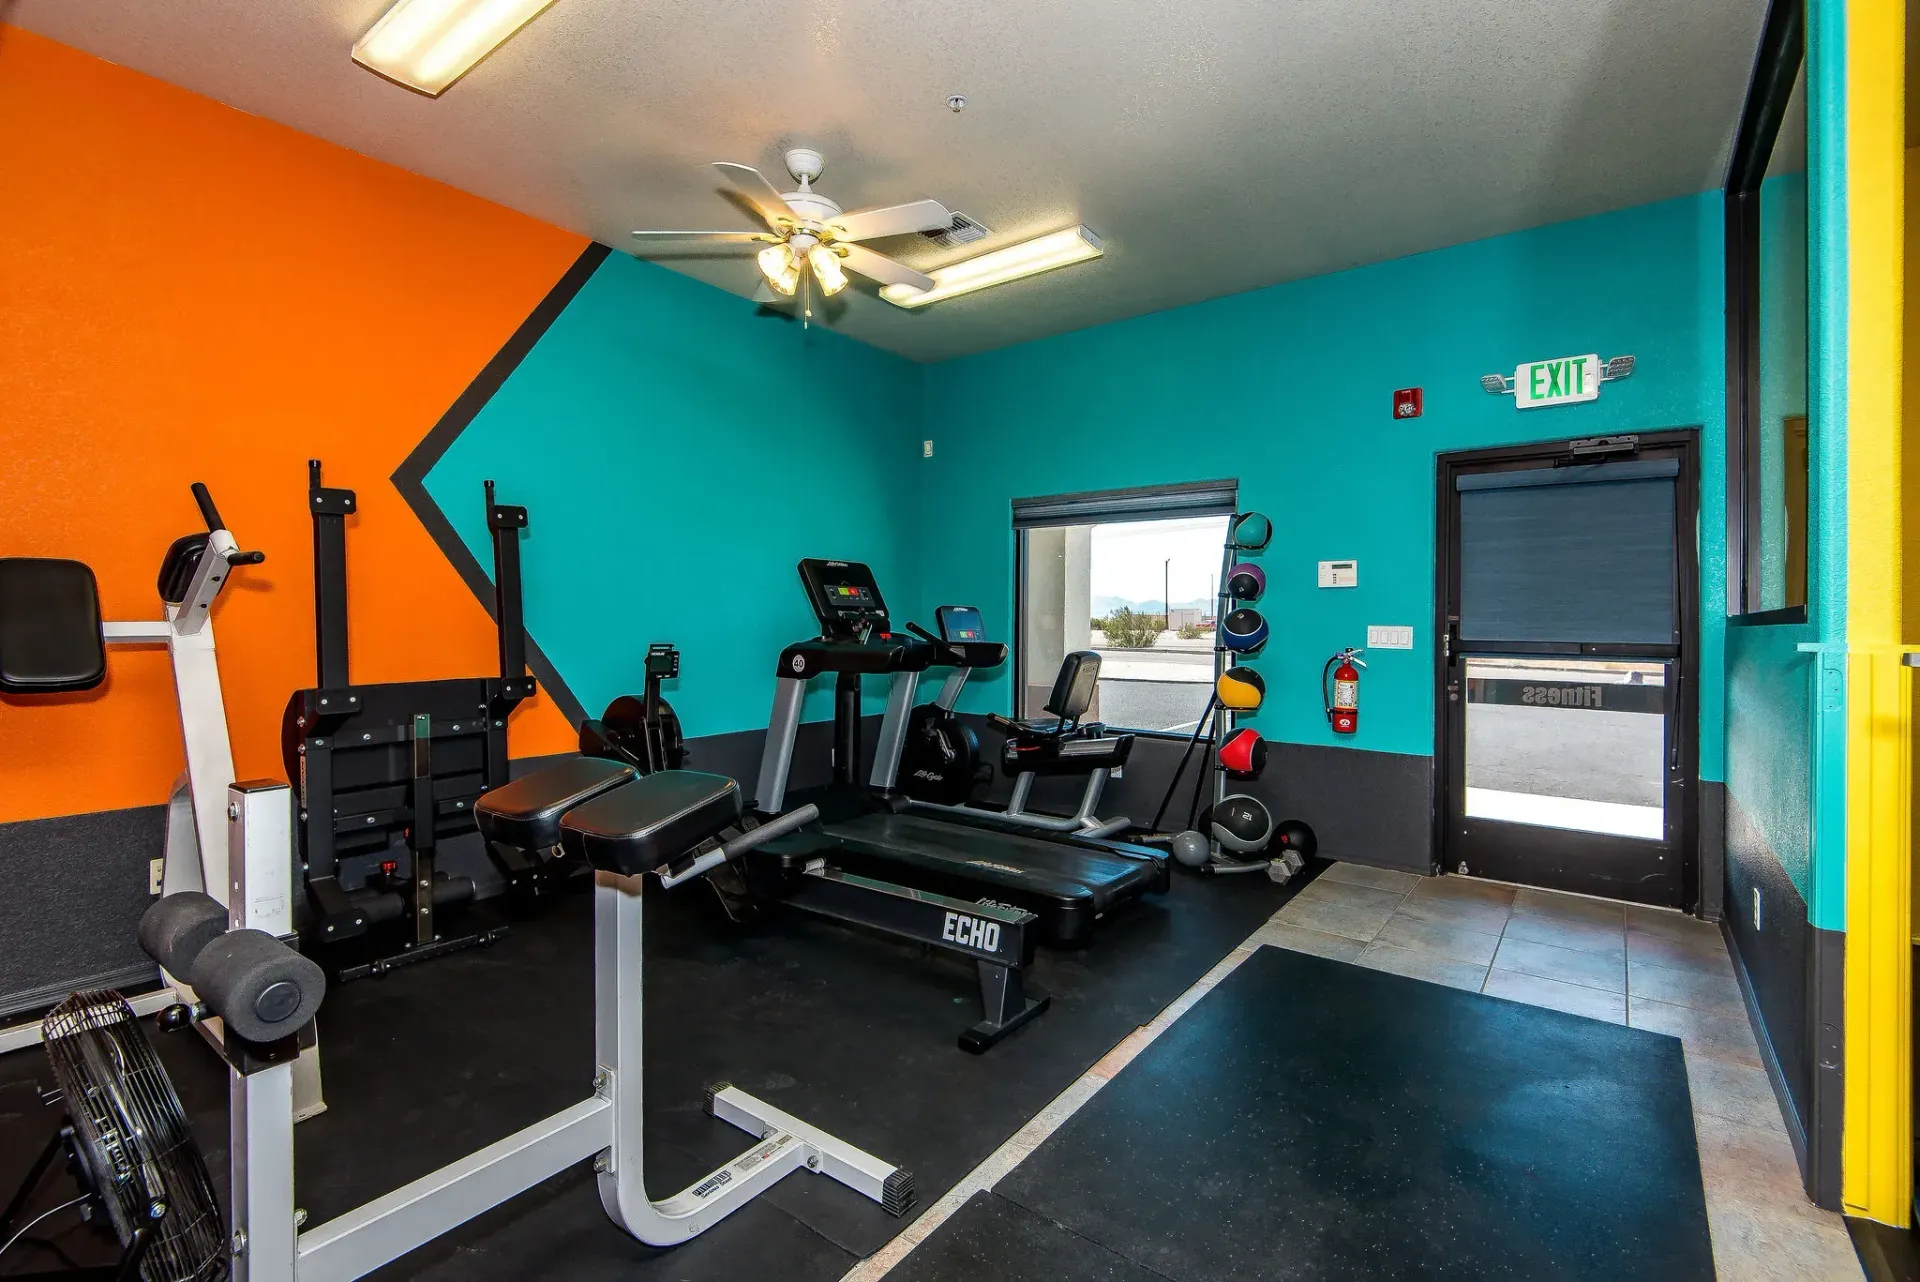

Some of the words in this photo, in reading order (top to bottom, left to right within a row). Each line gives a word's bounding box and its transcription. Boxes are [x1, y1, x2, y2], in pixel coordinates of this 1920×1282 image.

[1530, 358, 1587, 400] EXIT
[793, 659, 804, 668] 40
[942, 911, 1001, 952] ECHO
